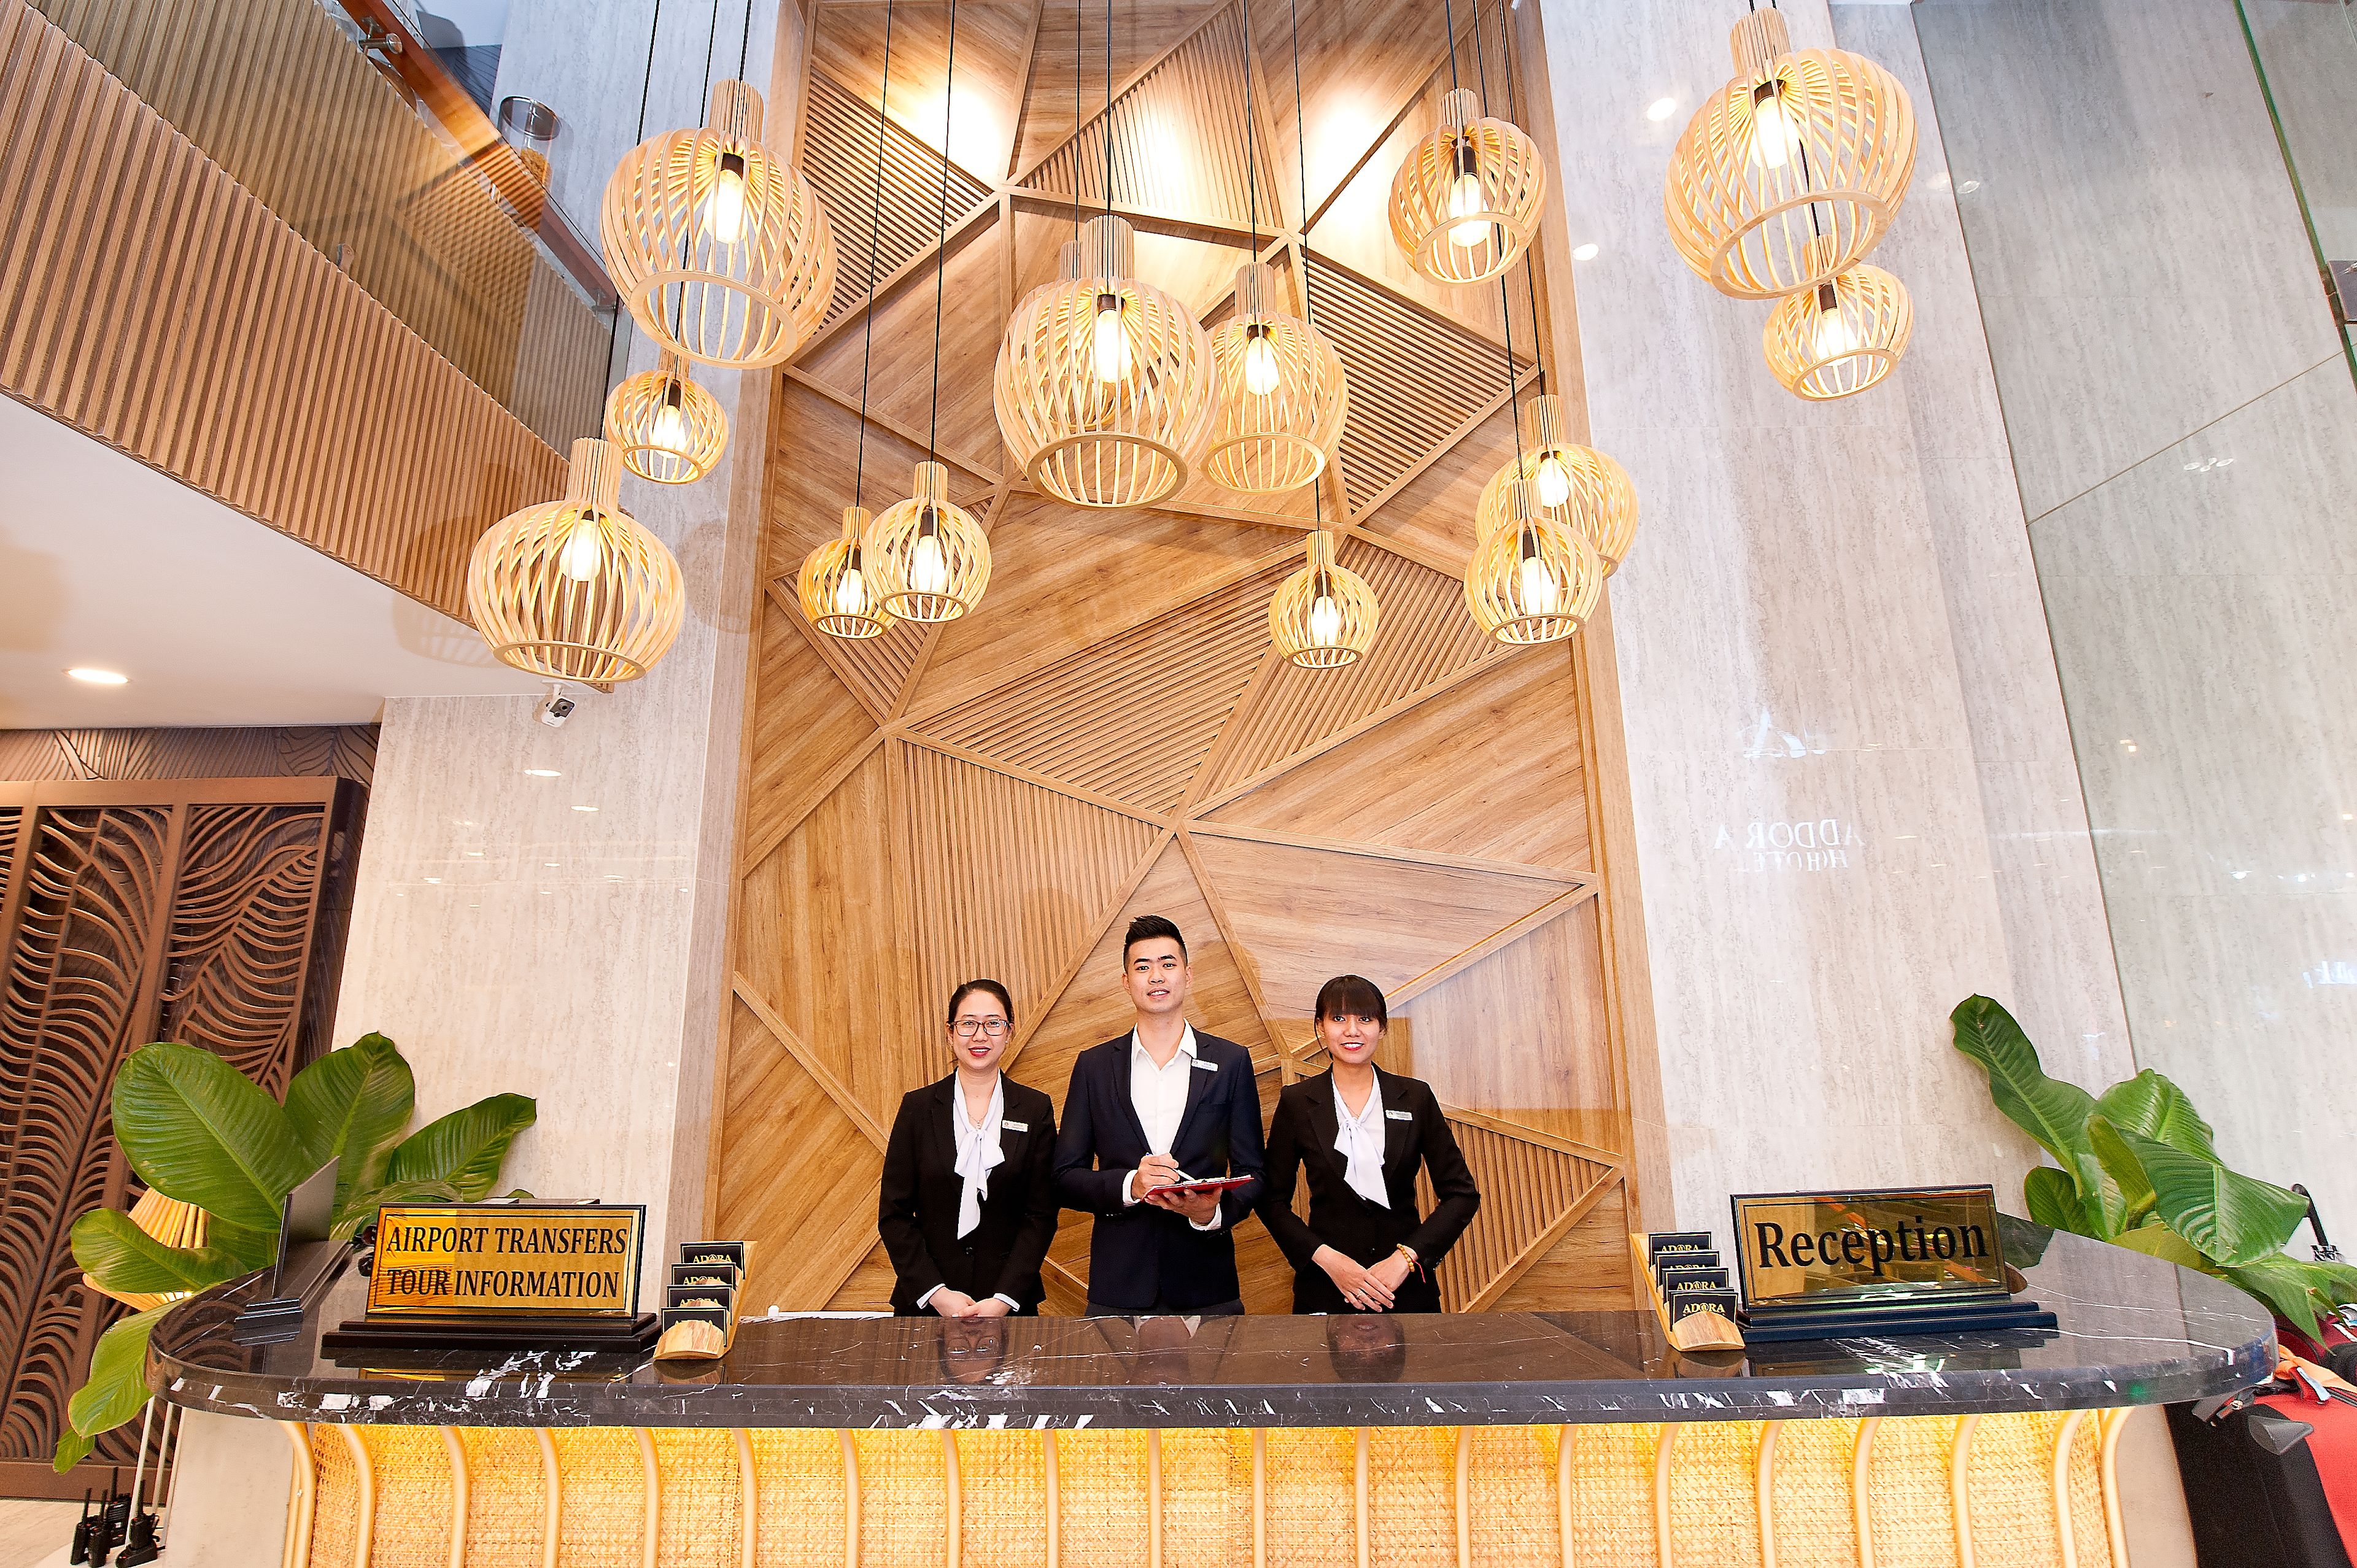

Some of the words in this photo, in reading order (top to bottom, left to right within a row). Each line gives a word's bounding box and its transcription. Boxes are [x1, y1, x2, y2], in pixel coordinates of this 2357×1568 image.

[385, 1226, 489, 1253] AIRPORT
[495, 1228, 627, 1254] TRANSFERS
[1754, 1215, 1989, 1276] Reception
[387, 1269, 448, 1295] TOUR
[454, 1270, 619, 1297] INFORMATION
[1677, 1281, 1717, 1291] ADORA
[1682, 1303, 1725, 1313] ADORA
